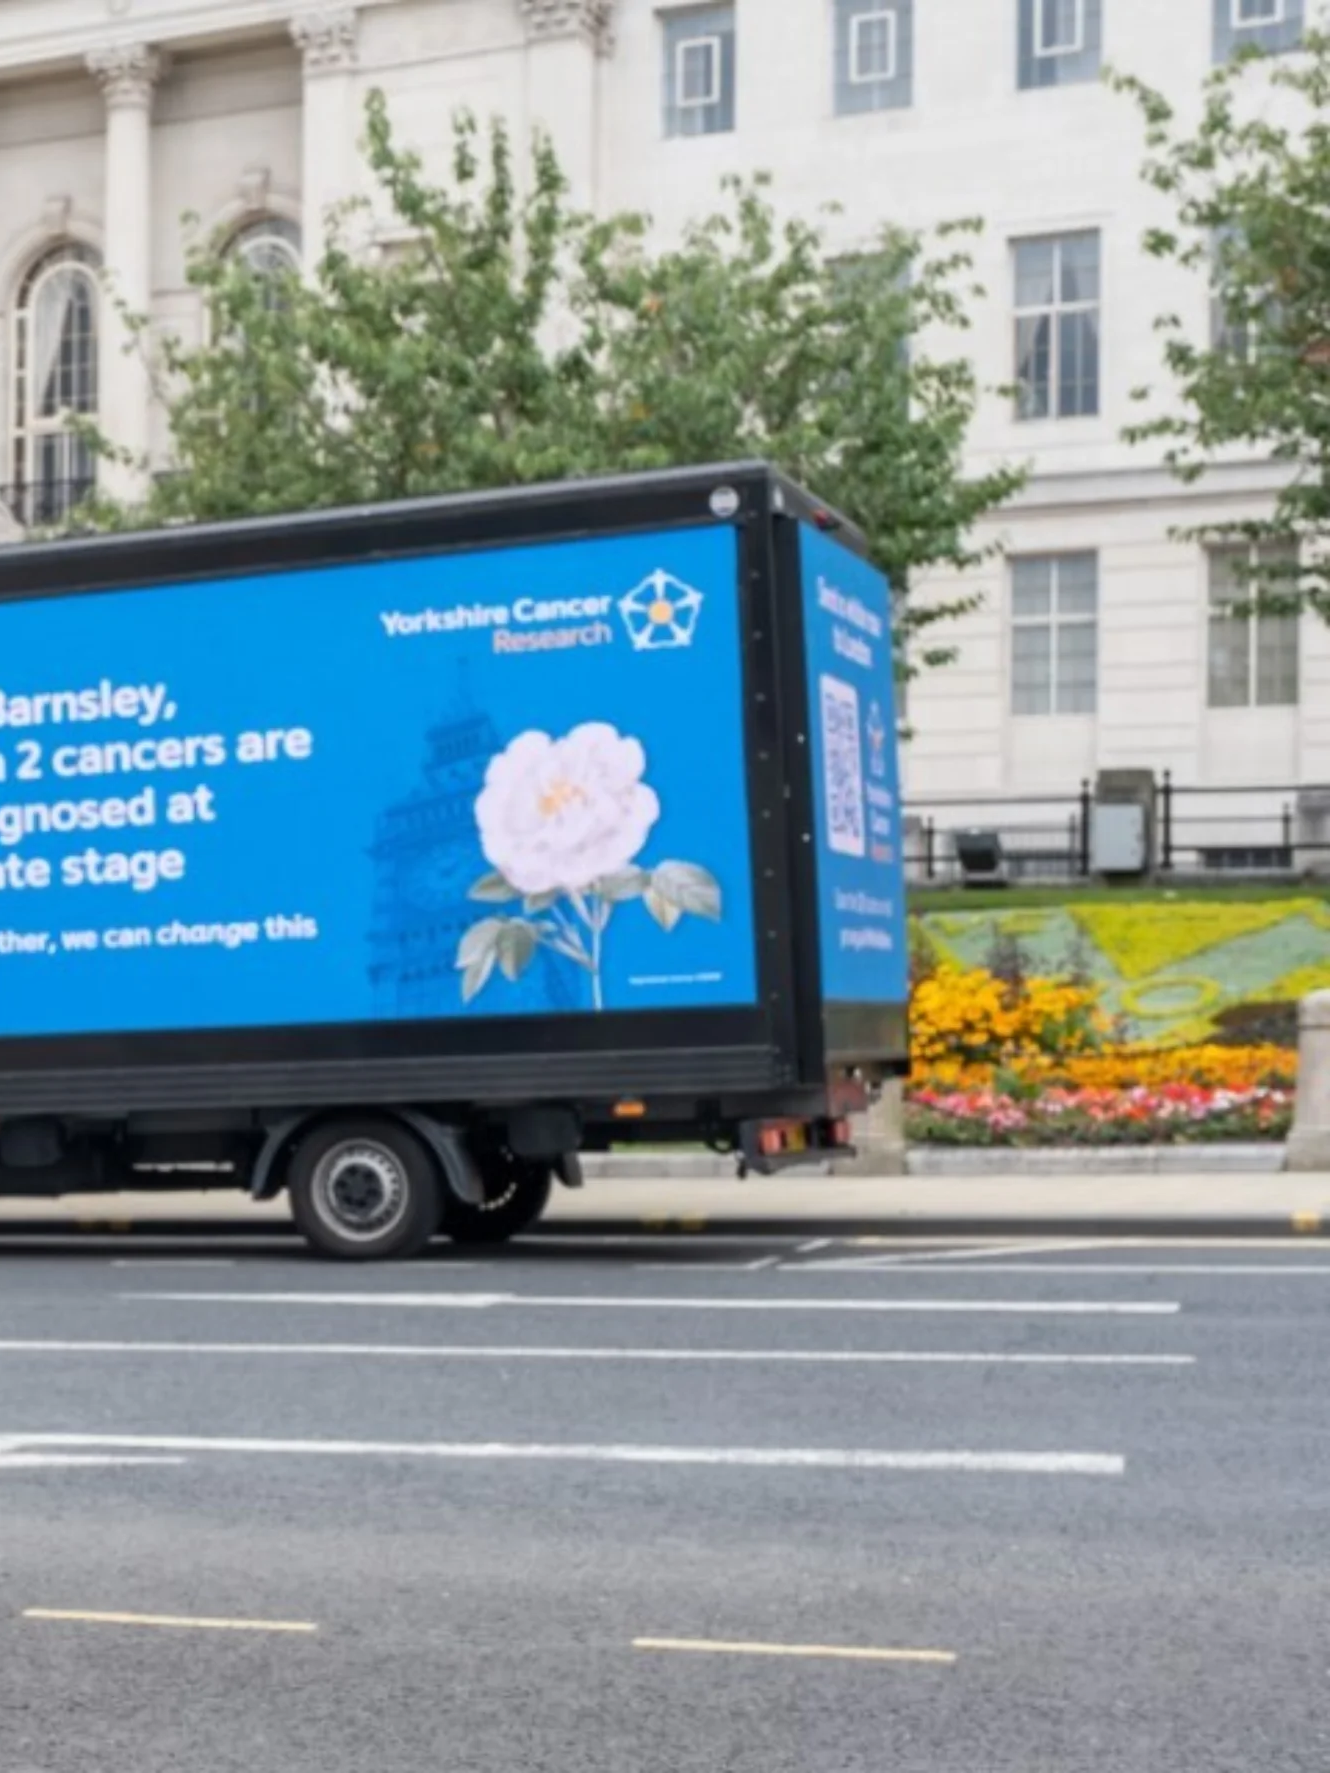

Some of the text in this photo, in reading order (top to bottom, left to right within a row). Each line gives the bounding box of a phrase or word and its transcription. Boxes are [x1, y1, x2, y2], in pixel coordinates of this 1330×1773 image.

[380, 595, 613, 637] Yorkshire Cancer
[492, 620, 613, 654] Research
[15, 740, 43, 781] 2
[51, 734, 226, 777] cancers
[235, 726, 313, 763] are
[165, 784, 216, 824] at
[60, 847, 186, 891] stage
[61, 929, 99, 951] we
[102, 926, 152, 949] can
[155, 920, 260, 949] change
[263, 912, 318, 940] this
